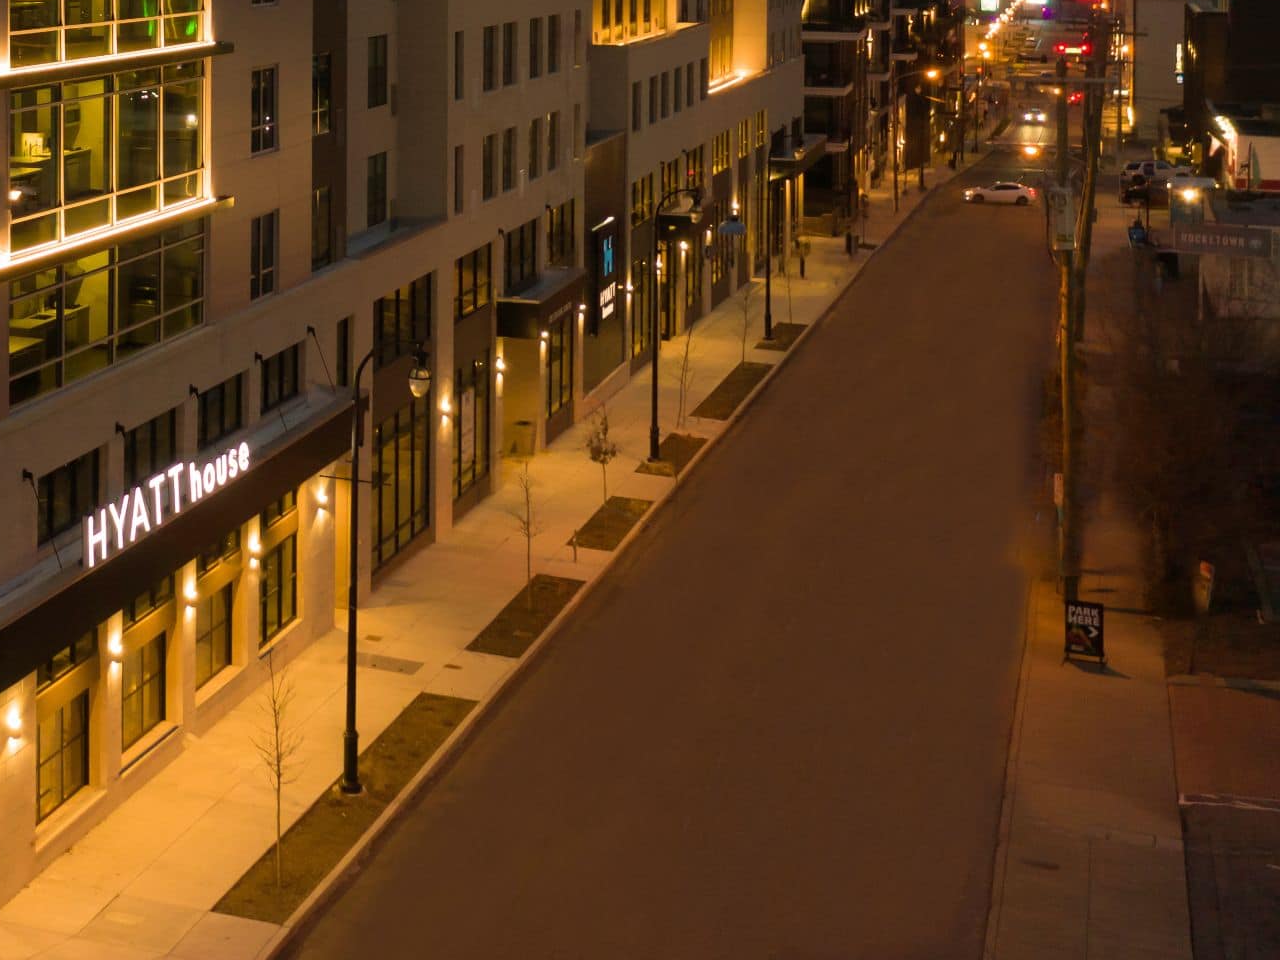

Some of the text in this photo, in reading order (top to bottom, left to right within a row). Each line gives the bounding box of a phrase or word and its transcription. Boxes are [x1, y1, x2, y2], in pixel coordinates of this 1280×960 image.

[87, 441, 250, 568] HYATT house
[1068, 605, 1099, 617] PARK
[1068, 614, 1100, 627] HERE
